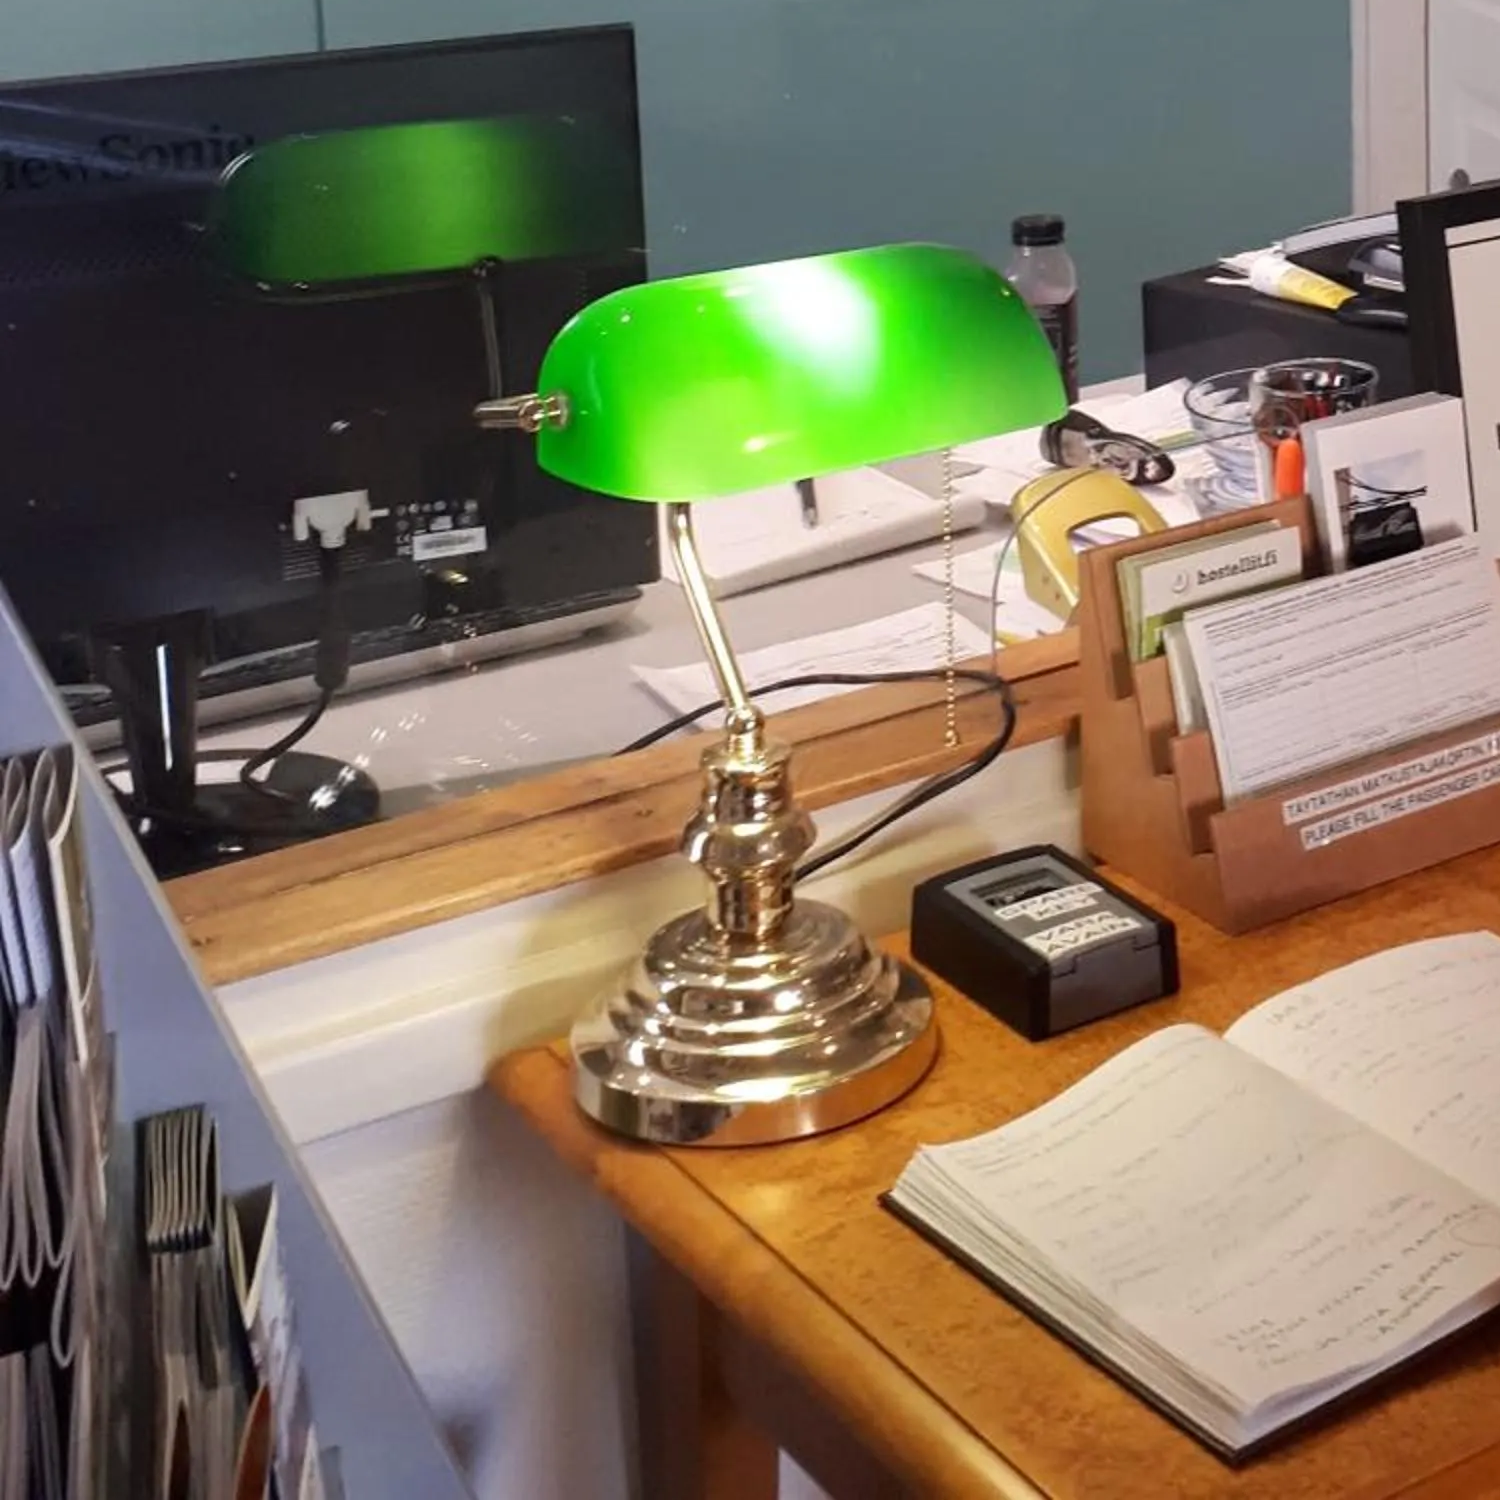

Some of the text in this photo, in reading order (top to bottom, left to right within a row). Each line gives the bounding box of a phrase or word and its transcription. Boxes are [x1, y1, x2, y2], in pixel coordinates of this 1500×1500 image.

[1304, 816, 1352, 844] PLEASE
[1353, 807, 1380, 830] FILL
[1381, 797, 1404, 818] THE
[1407, 774, 1480, 806] PASSENGER
[1001, 884, 1096, 916] SPARE
[1035, 911, 1115, 941] VARA
[1047, 920, 1132, 953] AVAIN
